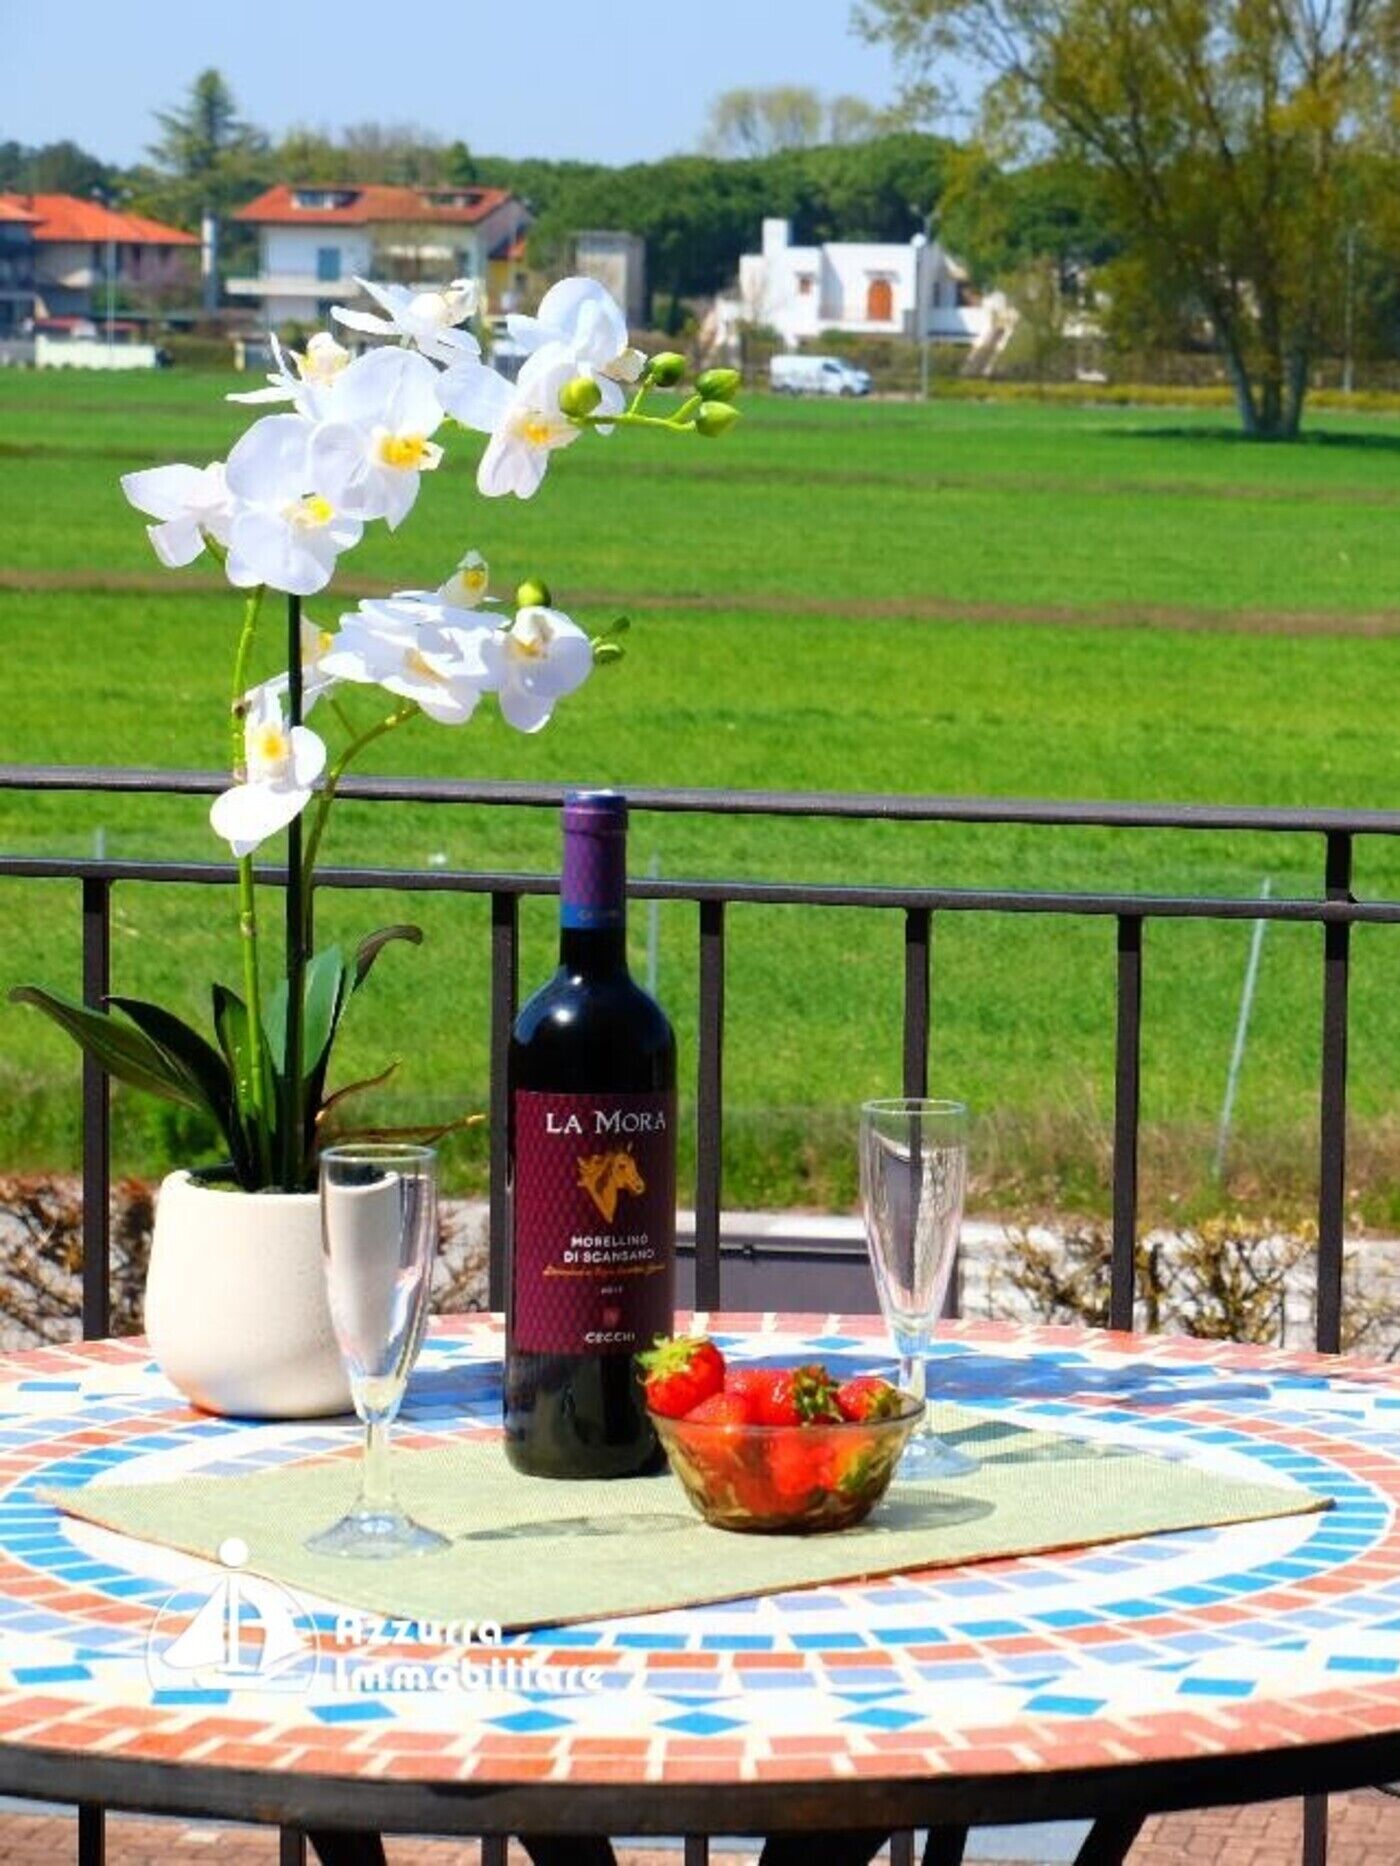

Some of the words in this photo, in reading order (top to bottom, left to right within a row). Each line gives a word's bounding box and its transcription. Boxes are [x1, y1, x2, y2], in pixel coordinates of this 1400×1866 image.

[546, 1112, 582, 1134] LA
[595, 1109, 666, 1133] MORA
[571, 1234, 648, 1247] MORELLINO
[564, 1251, 578, 1263] DI
[584, 1249, 655, 1263] SCANSANO
[585, 1332, 636, 1344] CECCHI
